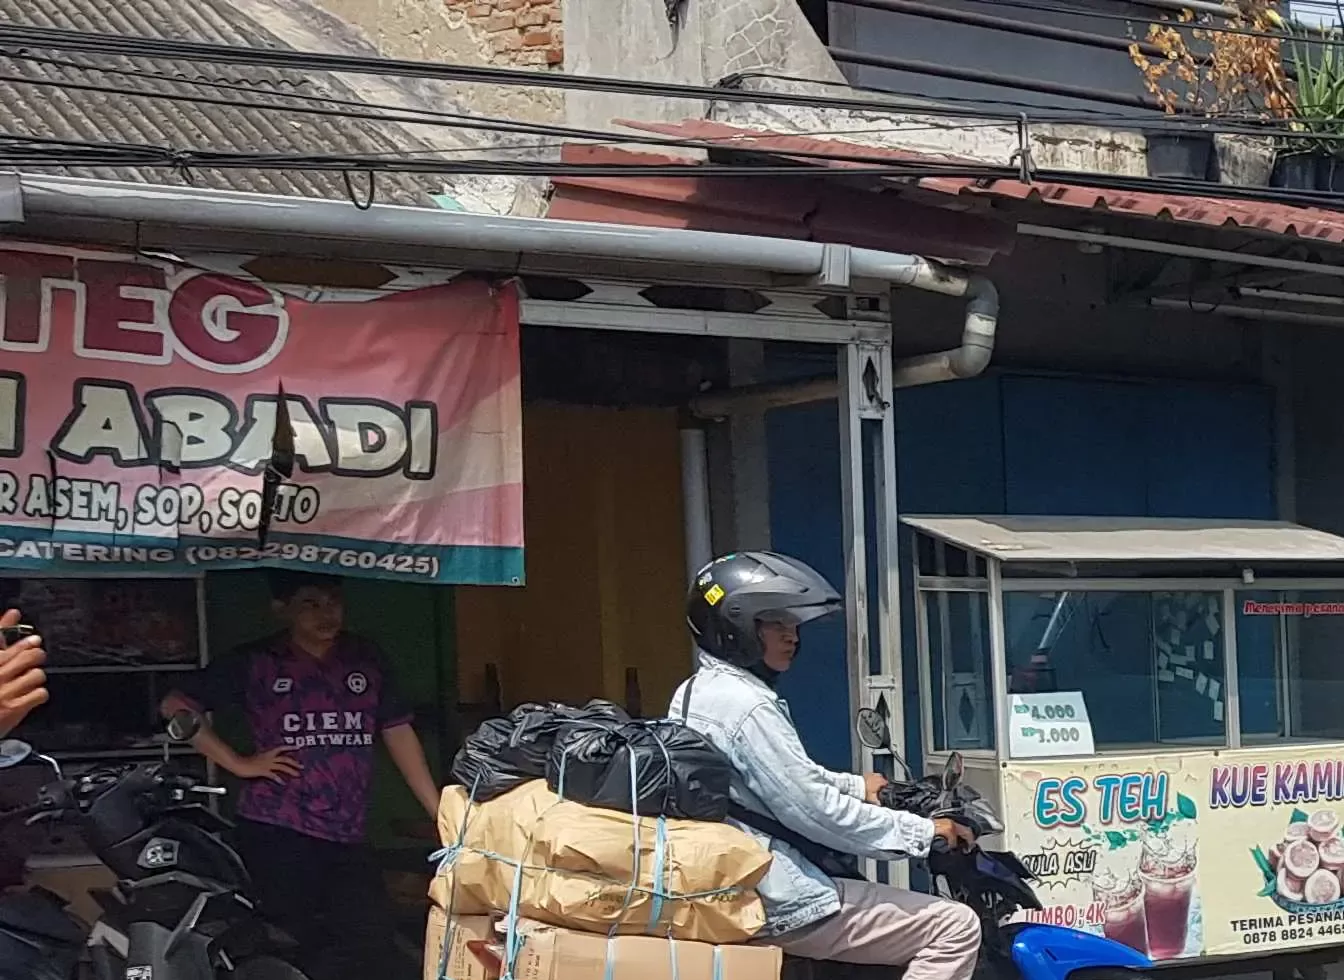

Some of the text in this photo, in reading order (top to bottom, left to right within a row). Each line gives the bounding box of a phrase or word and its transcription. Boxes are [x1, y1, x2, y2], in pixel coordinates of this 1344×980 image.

[50, 377, 437, 479] ABADI
[134, 483, 213, 533] SOP,
[283, 711, 363, 732] CIEM
[1033, 771, 1168, 828] ES TEH
[1208, 763, 1268, 809] KUE
[1063, 849, 1097, 875] ASLI
[1230, 916, 1284, 932] TERIMA
[1243, 930, 1277, 945] 0878
[1281, 927, 1313, 941] 8824
